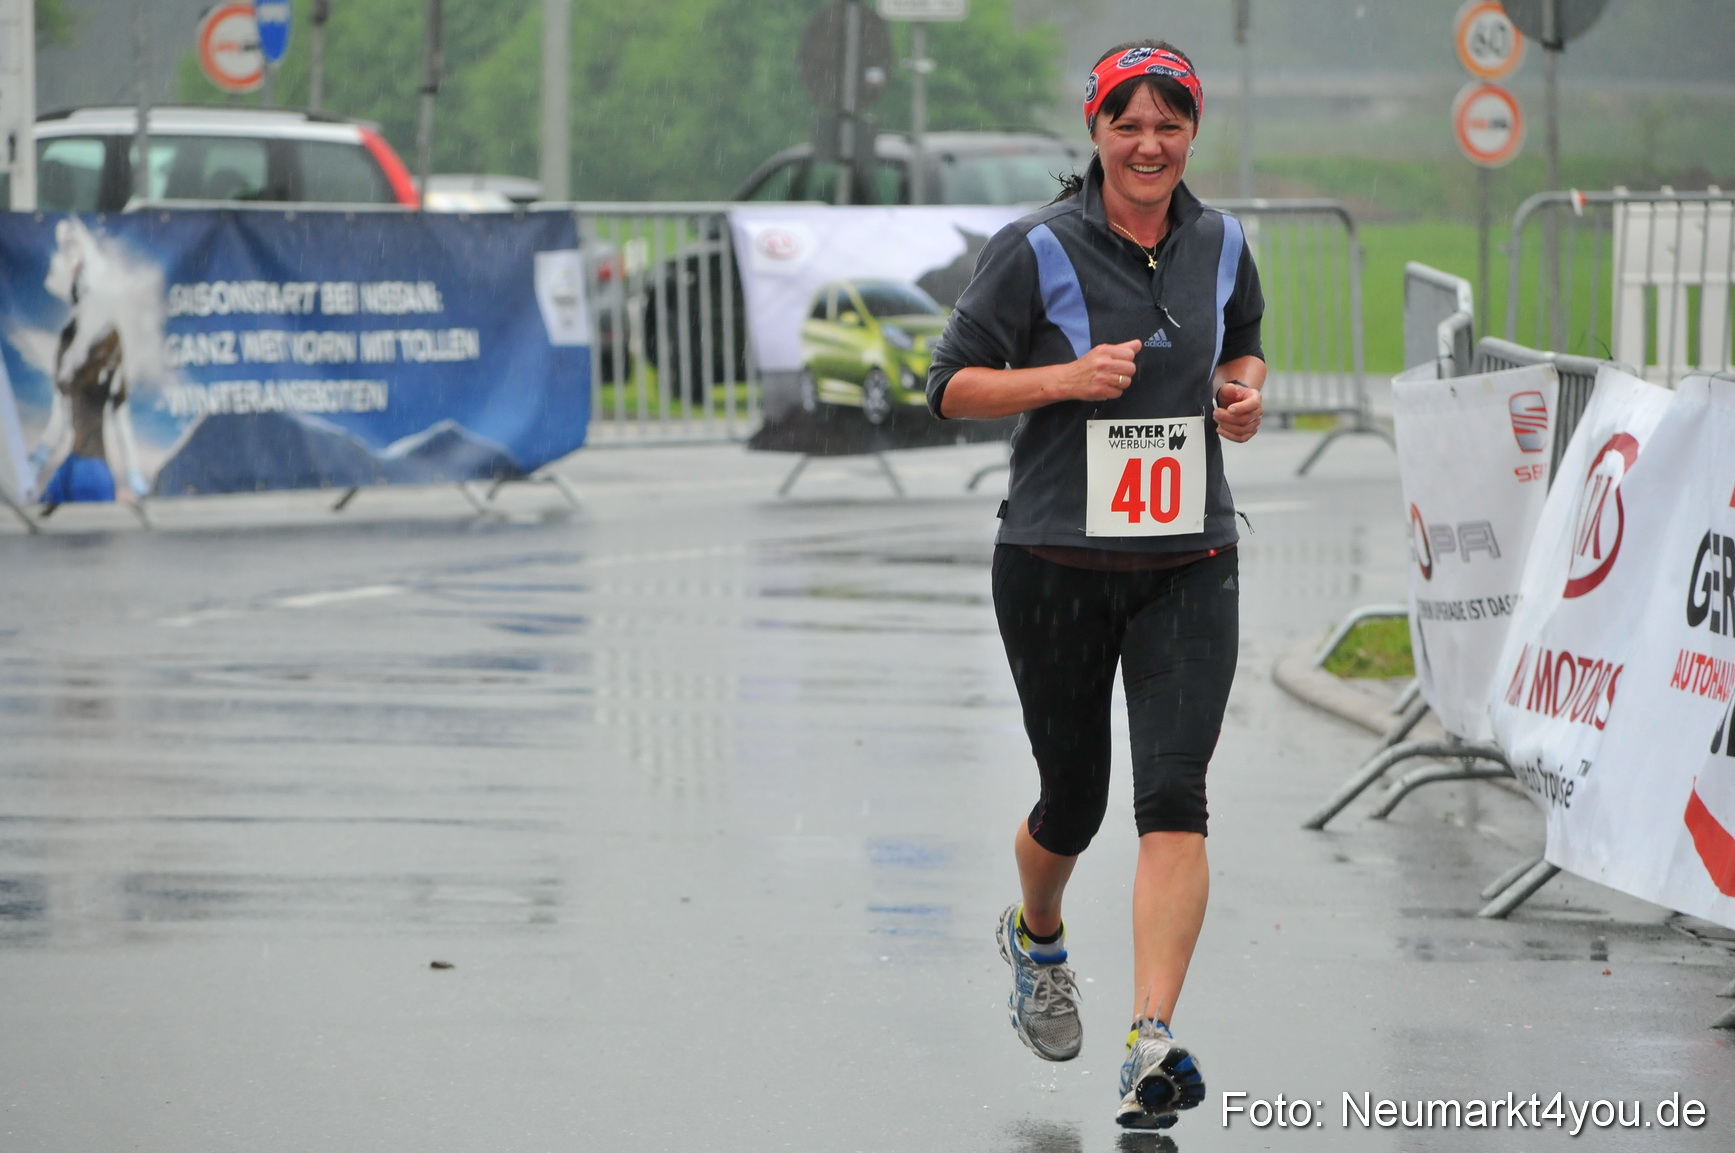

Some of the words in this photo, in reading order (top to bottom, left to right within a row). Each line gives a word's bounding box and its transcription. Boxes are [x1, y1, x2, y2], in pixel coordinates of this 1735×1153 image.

[167, 281, 318, 318] SAISONSTART
[320, 281, 359, 316] BEI
[166, 331, 239, 366] GANZ
[240, 330, 287, 364] WEIT
[289, 331, 357, 365] VORN
[360, 330, 396, 364] MIT
[397, 328, 480, 363] TOLLEN
[1144, 340, 1172, 348] adidas
[1108, 425, 1165, 439] MEYER
[1108, 439, 1166, 450] WERBUNG
[1111, 456, 1181, 523] 40
[1467, 599, 1487, 620] IST
[1487, 594, 1511, 617] DAS
[1526, 647, 1624, 731] MOTORS
